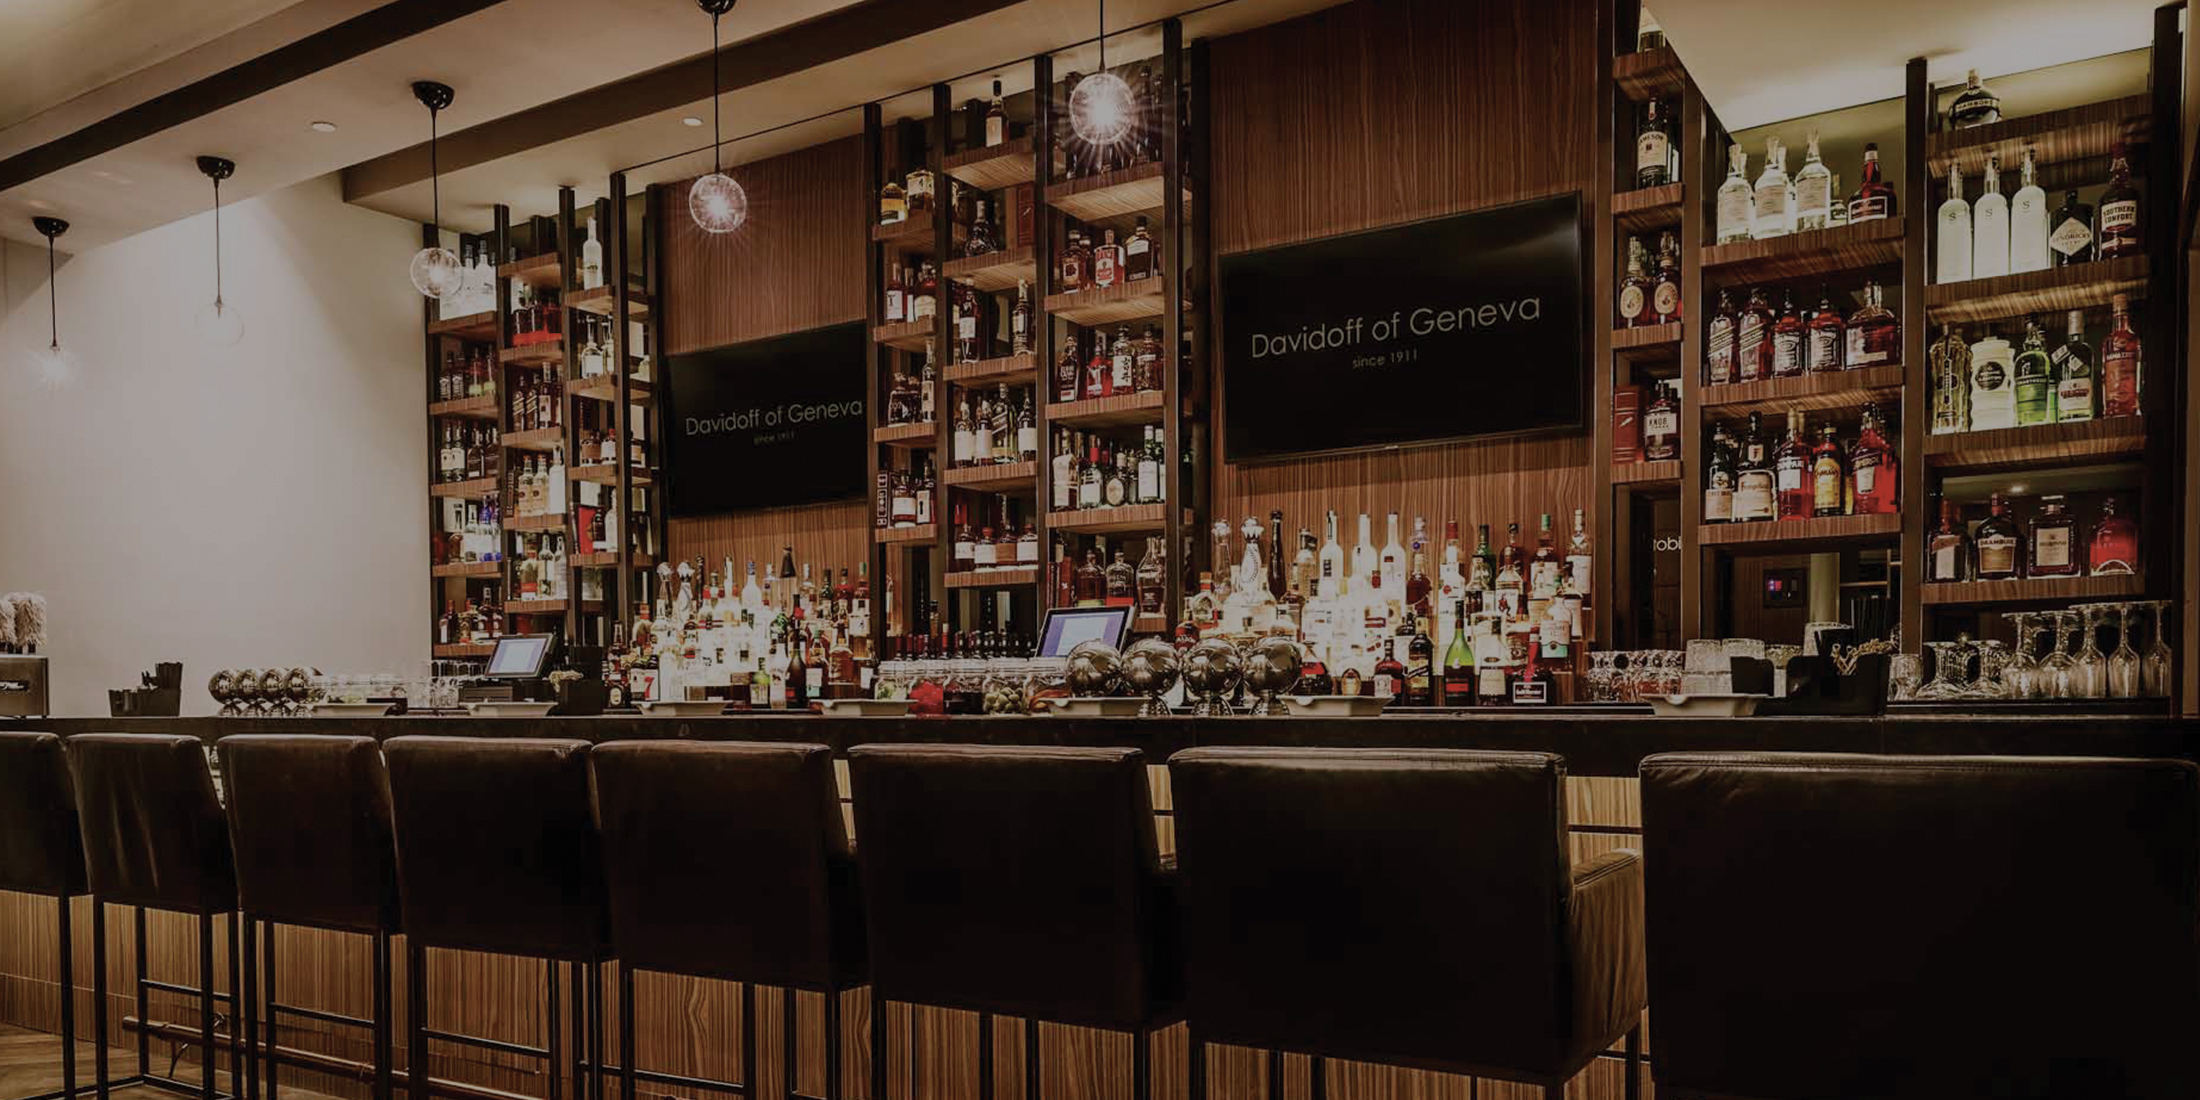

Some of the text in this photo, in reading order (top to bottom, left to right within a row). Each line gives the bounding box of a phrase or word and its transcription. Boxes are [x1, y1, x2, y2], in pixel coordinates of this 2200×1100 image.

[2103, 205, 2135, 217] SOUTHERN
[2104, 213, 2133, 224] COMFORT
[1251, 297, 1541, 358] Davidoff of Geneva
[1352, 348, 1418, 370] since 1911
[685, 401, 864, 436] Davidoff of Geneva
